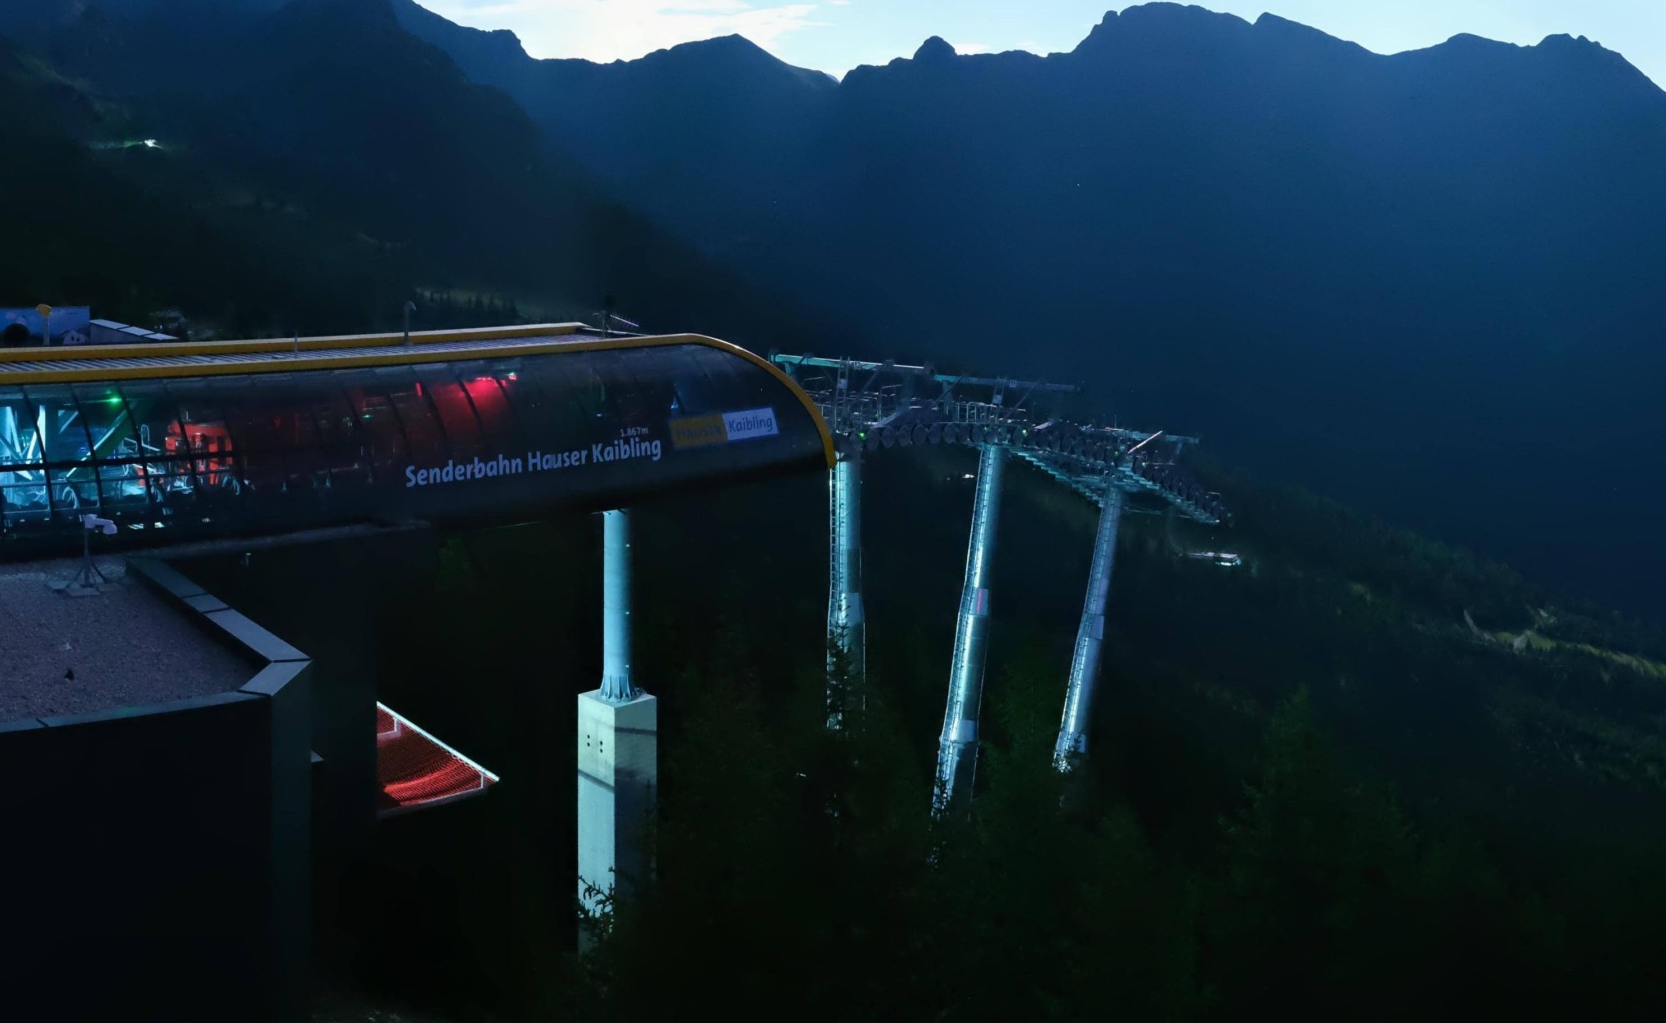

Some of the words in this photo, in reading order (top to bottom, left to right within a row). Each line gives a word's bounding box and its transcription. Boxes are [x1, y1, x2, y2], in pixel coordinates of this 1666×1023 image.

[619, 426, 649, 437] 1.867m
[728, 416, 773, 433] Kaibling
[405, 453, 523, 488] Senderbahn
[527, 449, 588, 472] Hauser
[591, 437, 662, 461] Kaibling
